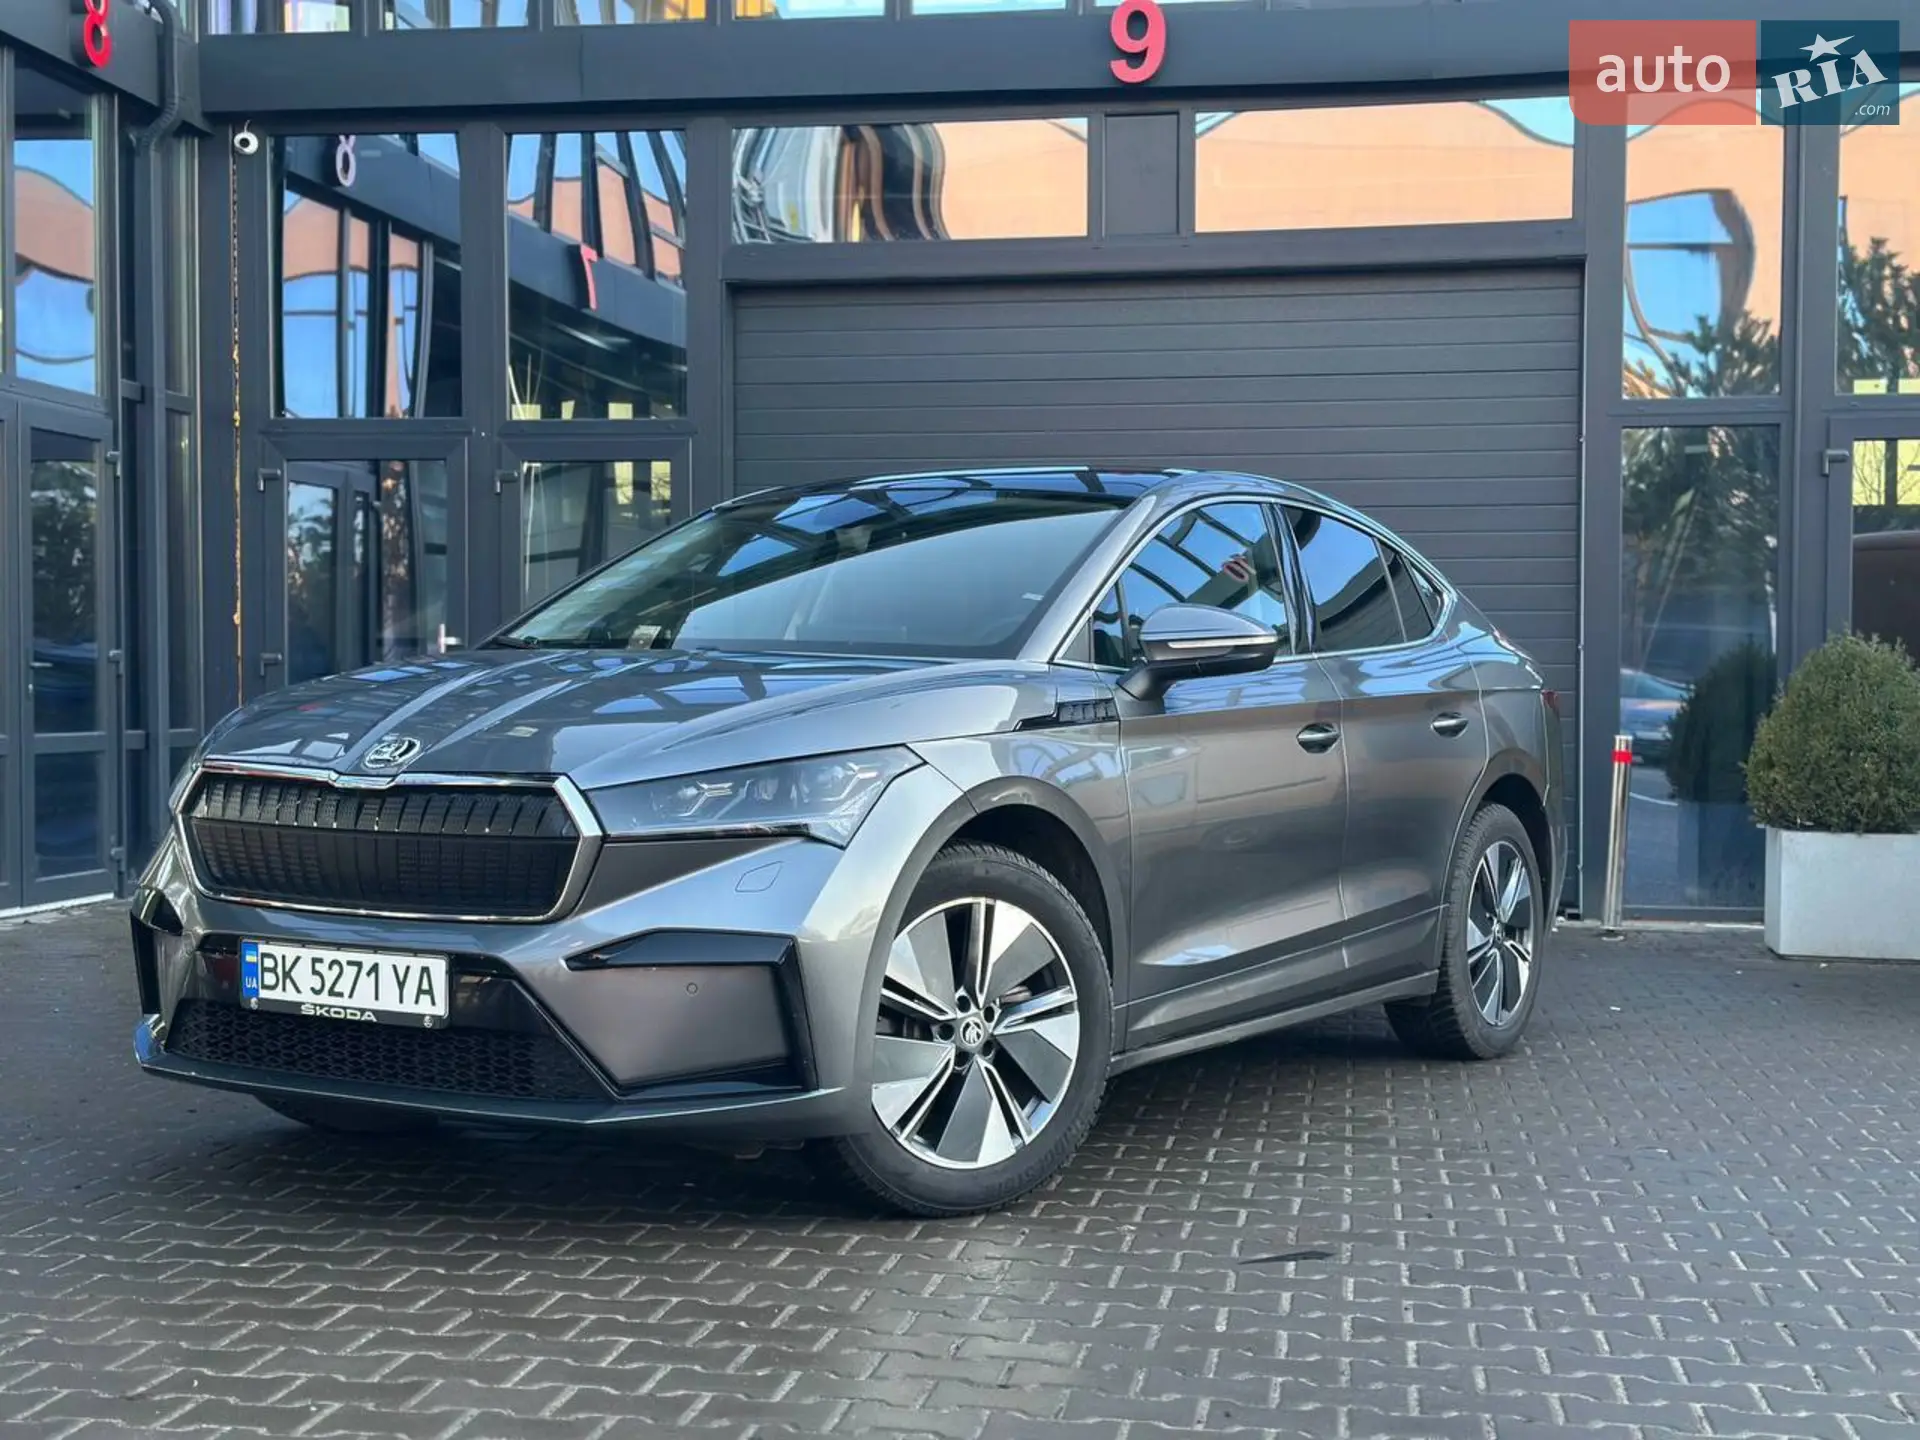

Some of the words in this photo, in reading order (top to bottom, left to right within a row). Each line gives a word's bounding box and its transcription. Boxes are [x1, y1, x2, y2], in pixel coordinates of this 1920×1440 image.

[83, 0, 112, 69] 8
[1109, 0, 1167, 84] 9
[245, 977, 257, 989] UA
[260, 952, 302, 994] BK
[310, 957, 380, 1001] 5271
[392, 963, 436, 1007] YA
